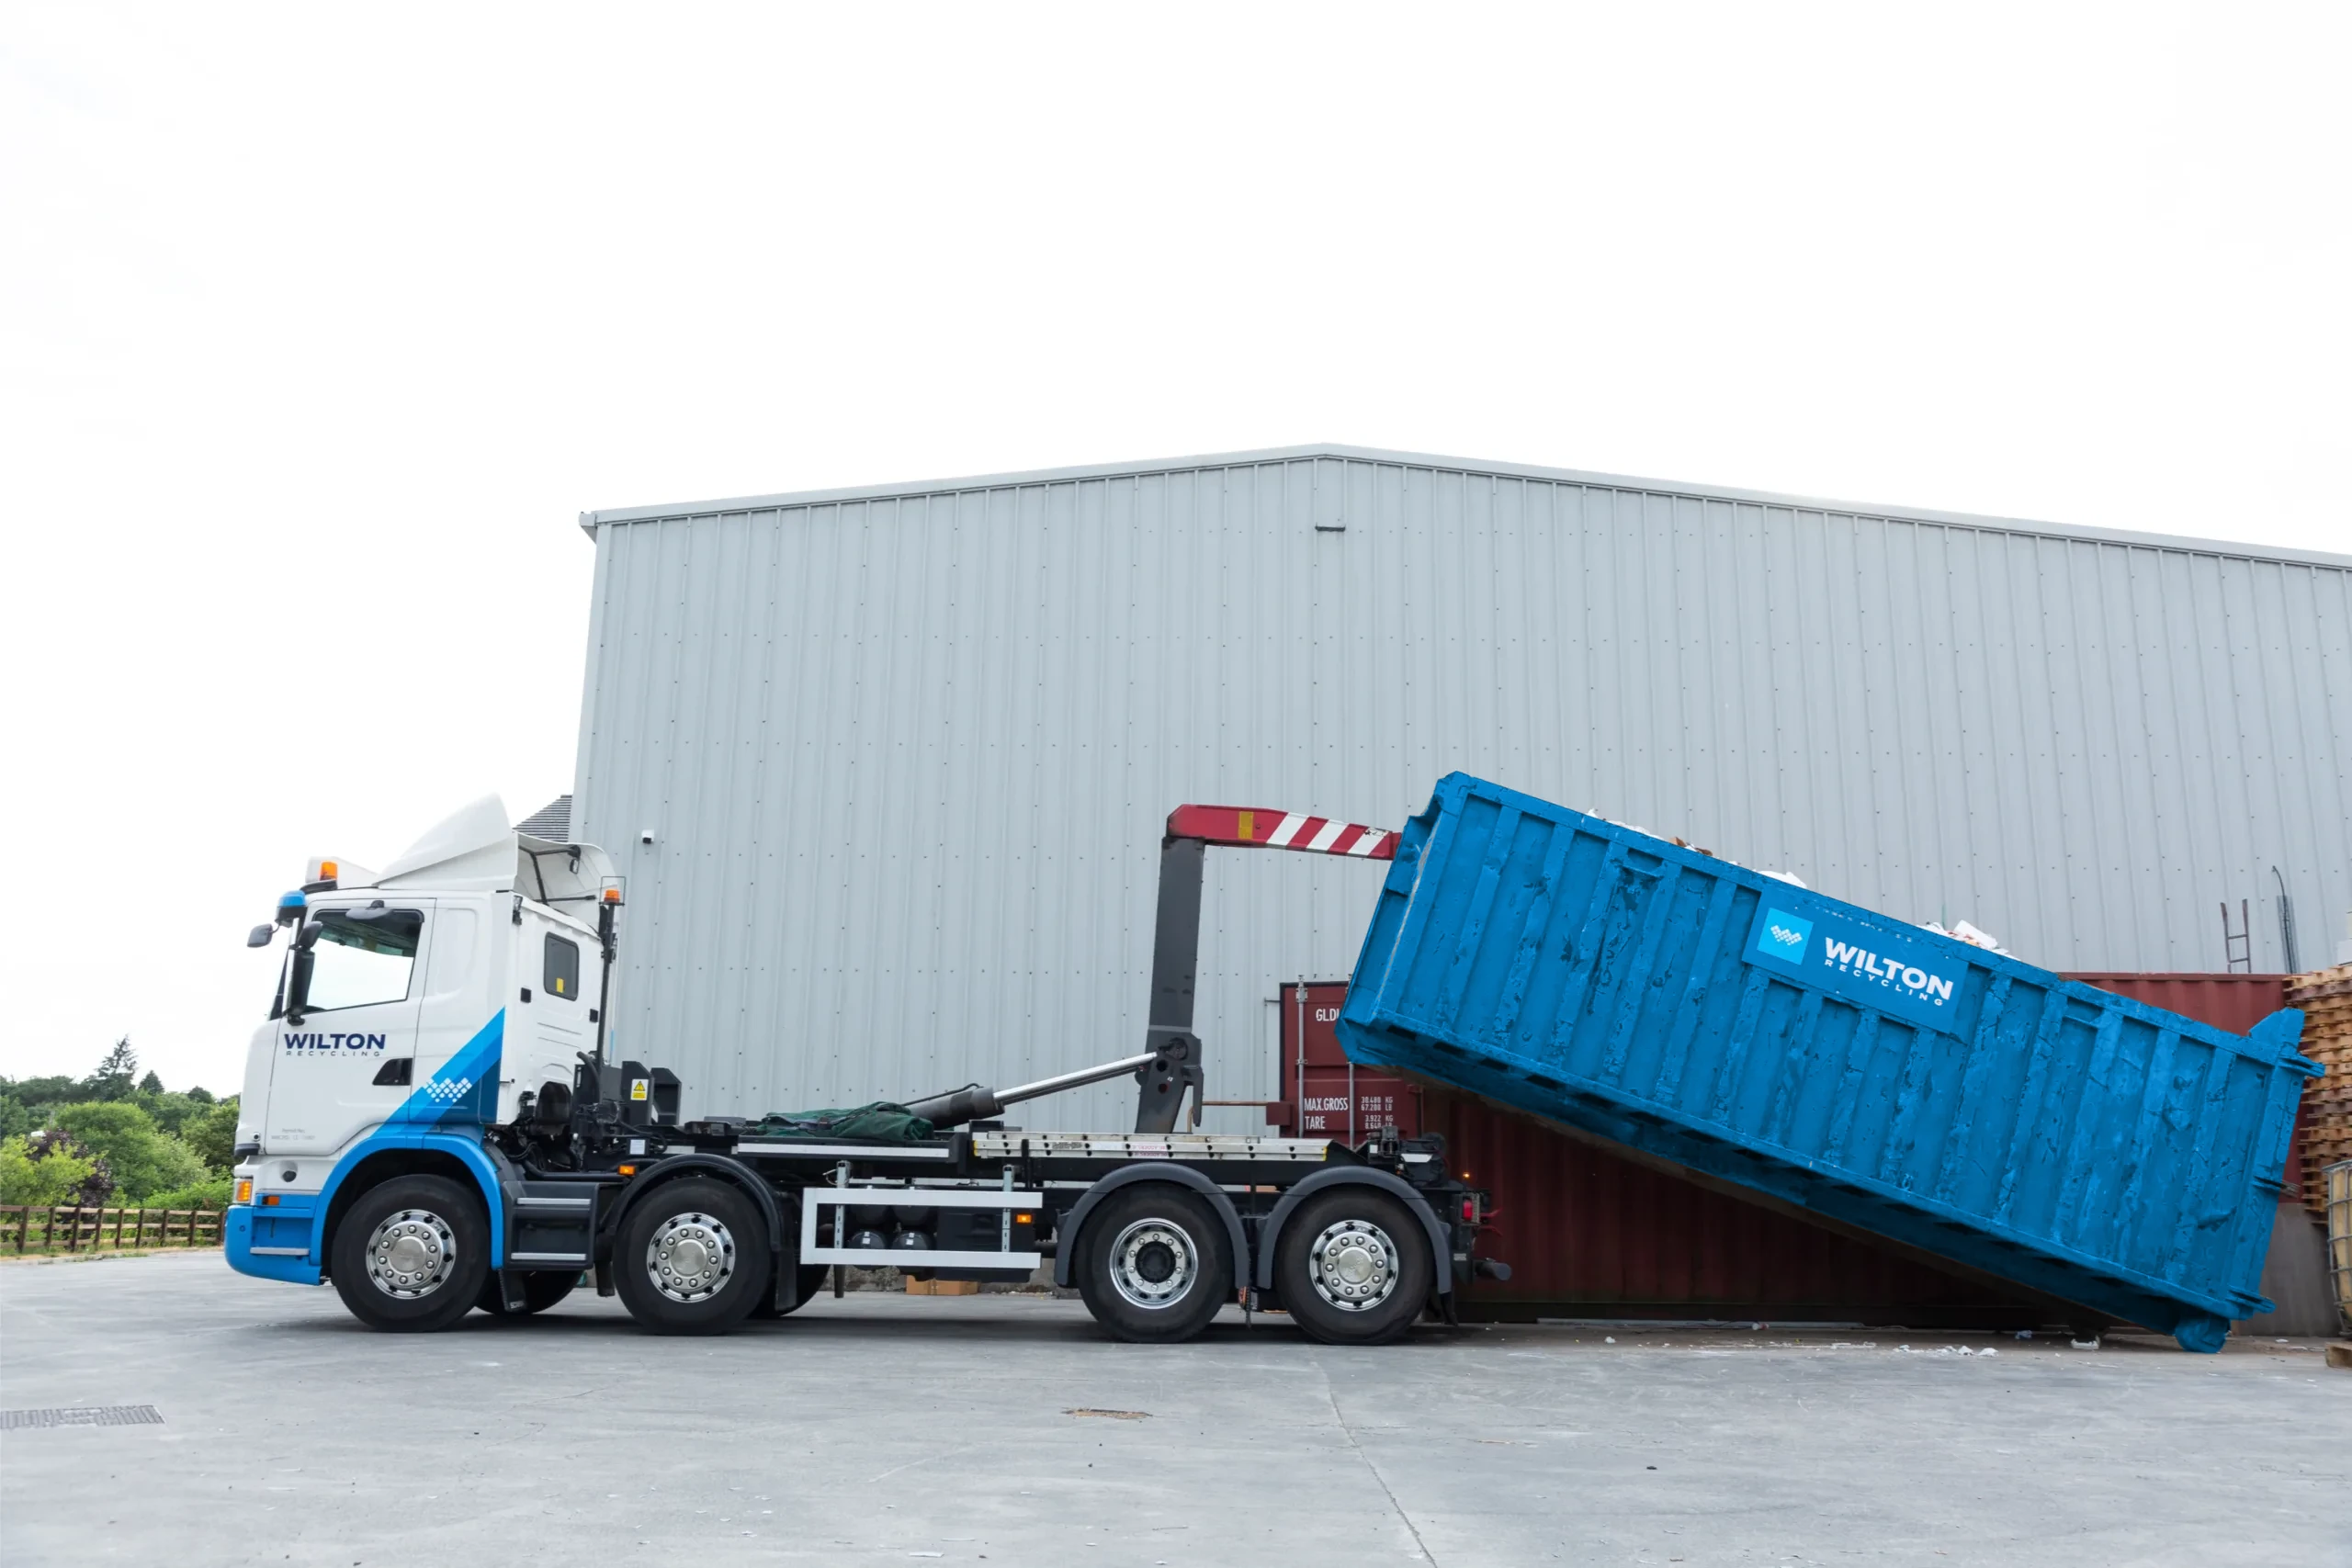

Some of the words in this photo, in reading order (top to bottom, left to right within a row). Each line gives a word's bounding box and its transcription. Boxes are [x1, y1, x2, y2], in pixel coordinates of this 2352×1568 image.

[1825, 936, 1953, 1000] WILTON
[1824, 958, 1943, 1006] RECYCLING
[284, 1033, 386, 1049] WILTON
[1305, 1116, 1326, 1129] TARE
[1385, 1114, 1394, 1122] KG
